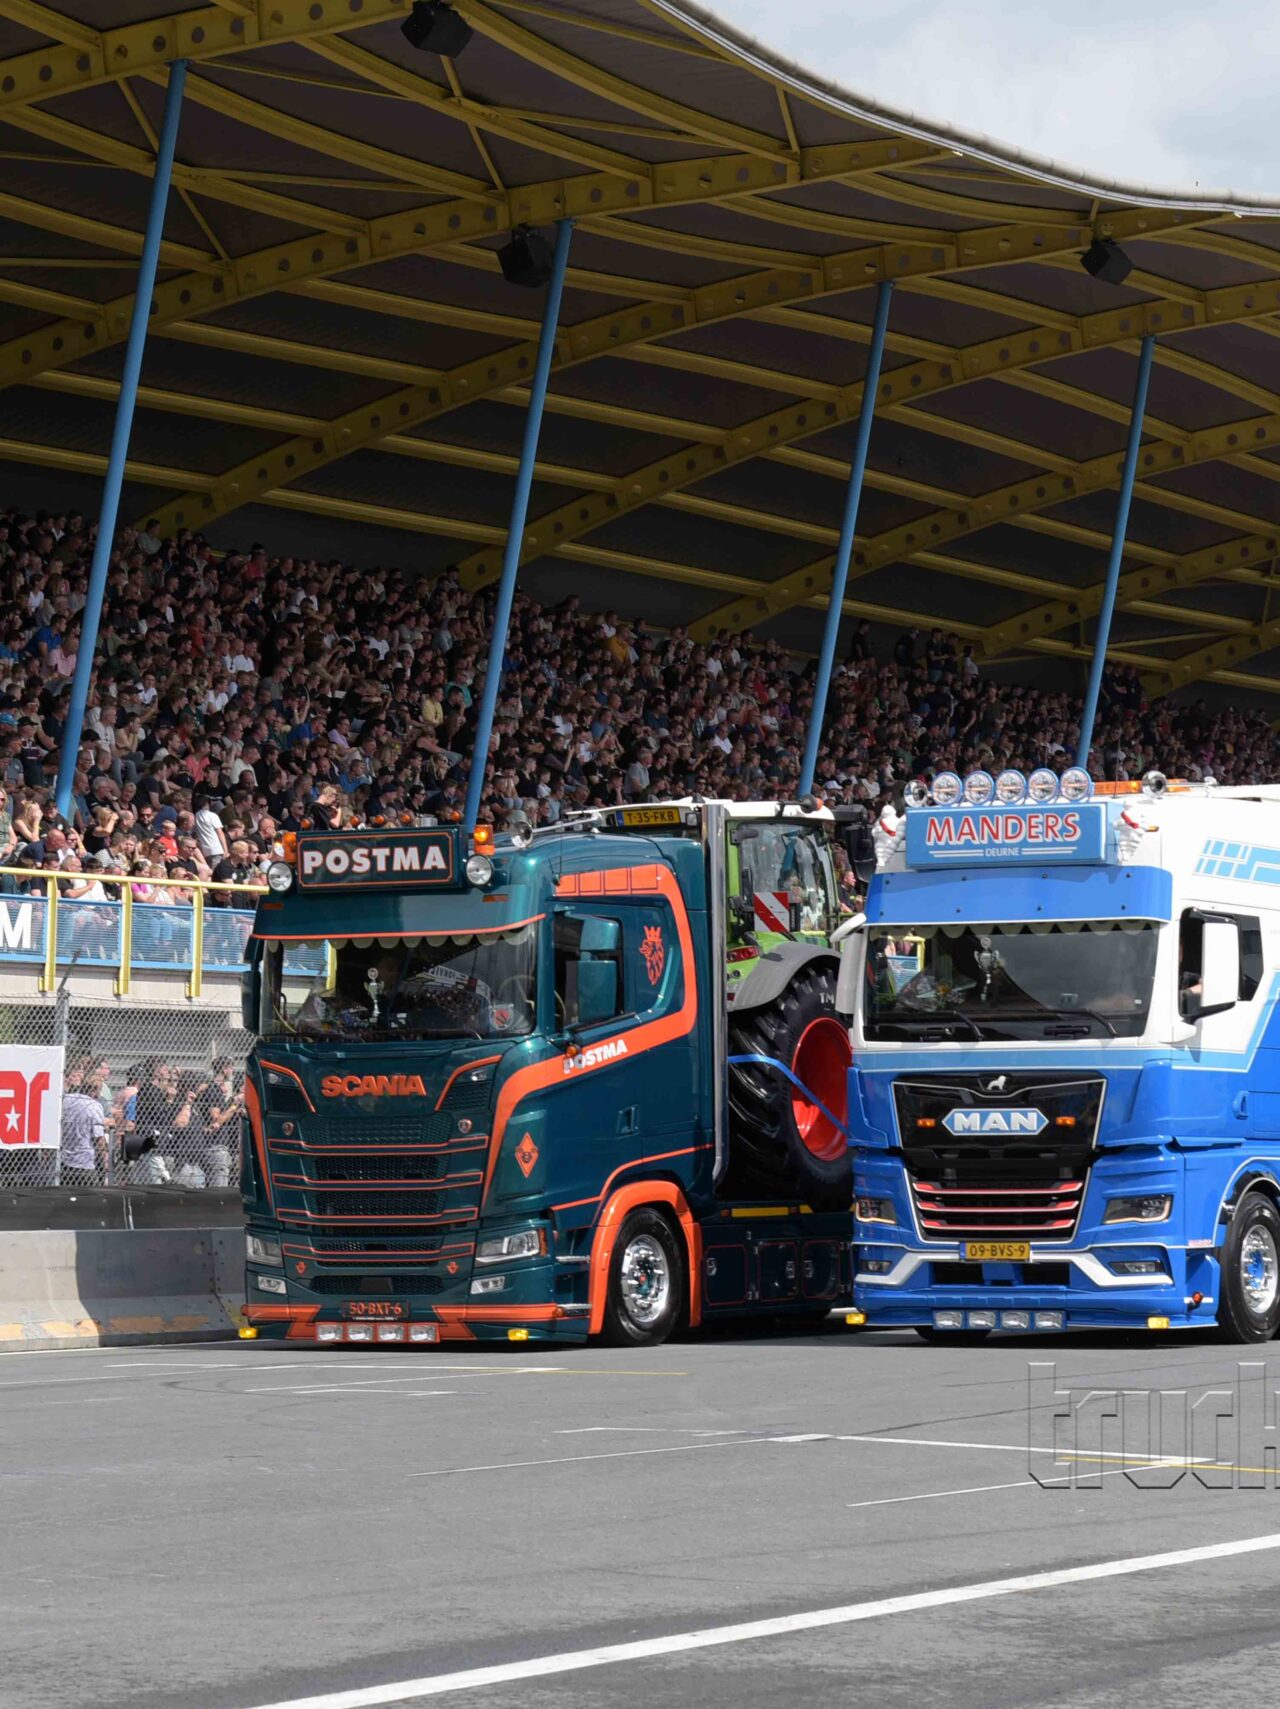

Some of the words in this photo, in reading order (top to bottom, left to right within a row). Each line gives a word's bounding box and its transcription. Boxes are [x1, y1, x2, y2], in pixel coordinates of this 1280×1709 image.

[626, 810, 674, 824] T-35-FKB
[926, 812, 1081, 846] MANDERS
[303, 846, 446, 875] POSTMA
[985, 848, 1019, 858] DEURNE
[563, 1039, 628, 1074] POSTMA
[321, 1074, 427, 1097] SCANIA
[953, 1112, 1038, 1131] MAN
[969, 1244, 1026, 1257] 09-BVS-9
[350, 1301, 402, 1316] 50-BXT-6
